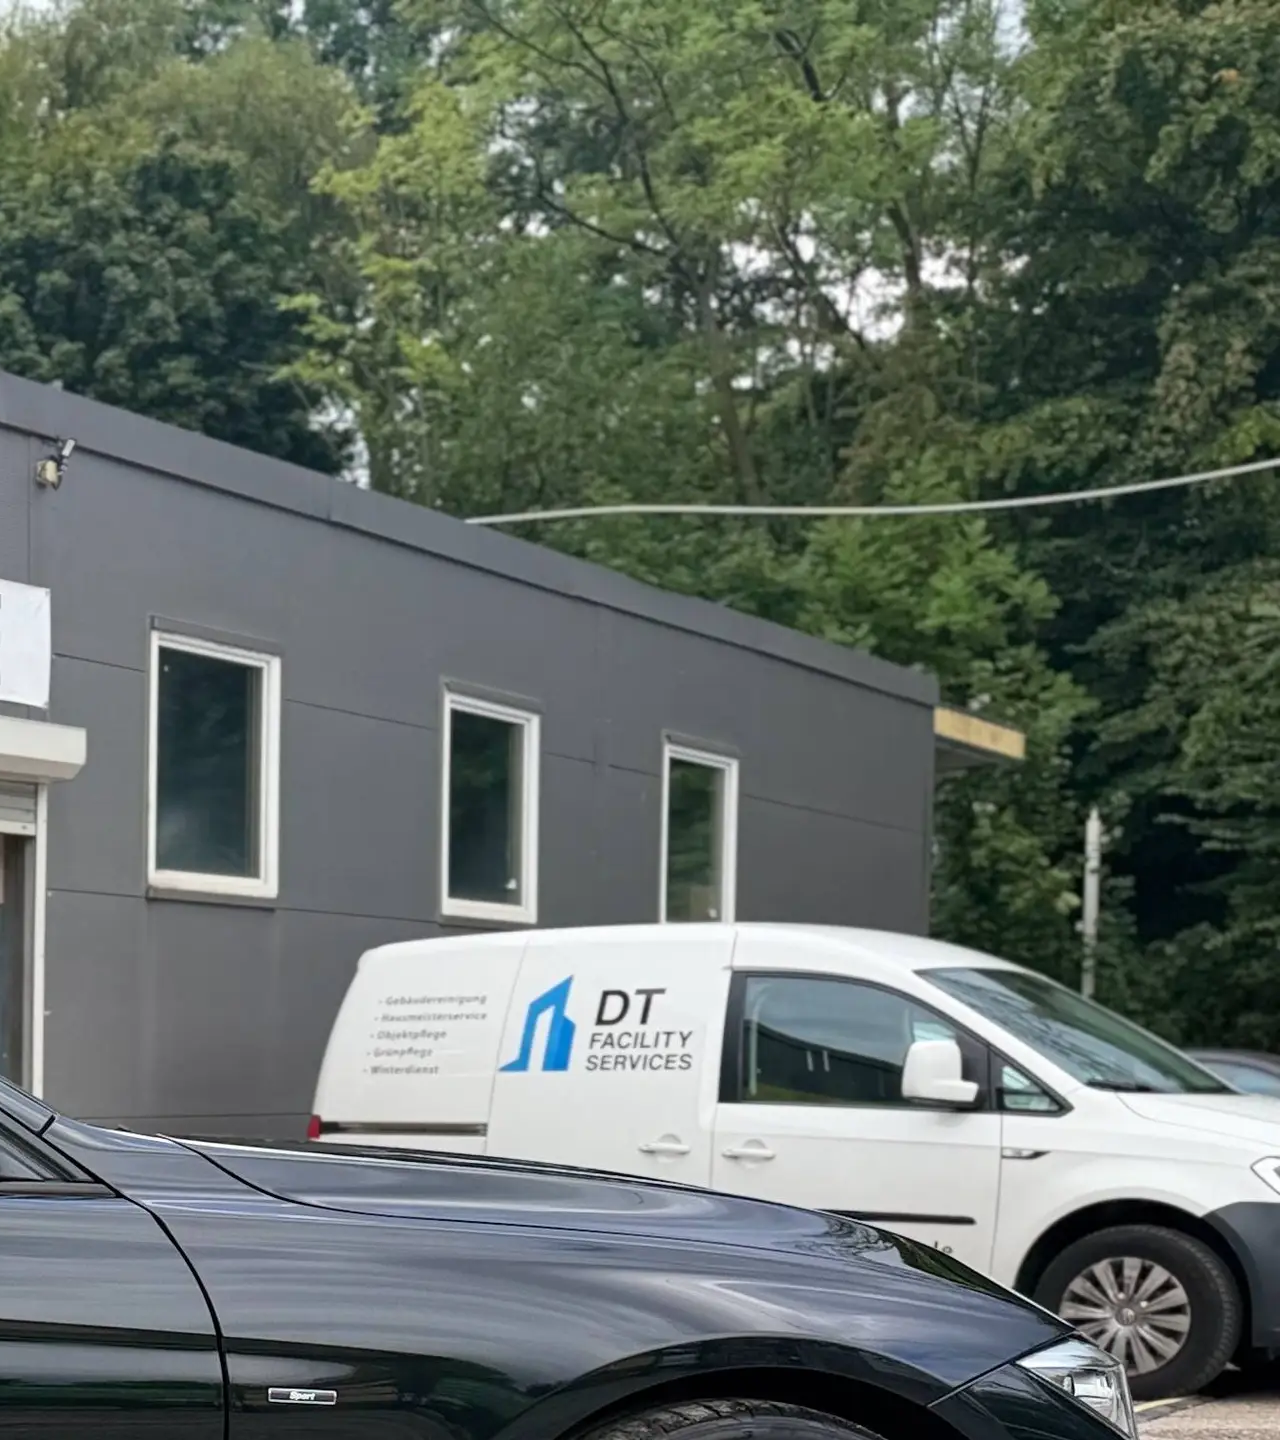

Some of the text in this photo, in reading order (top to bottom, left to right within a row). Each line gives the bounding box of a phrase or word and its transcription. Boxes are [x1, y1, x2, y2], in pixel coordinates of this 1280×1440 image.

[595, 987, 667, 1026] DT
[588, 1031, 693, 1050] FACILITY
[585, 1053, 693, 1072] SERVICES
